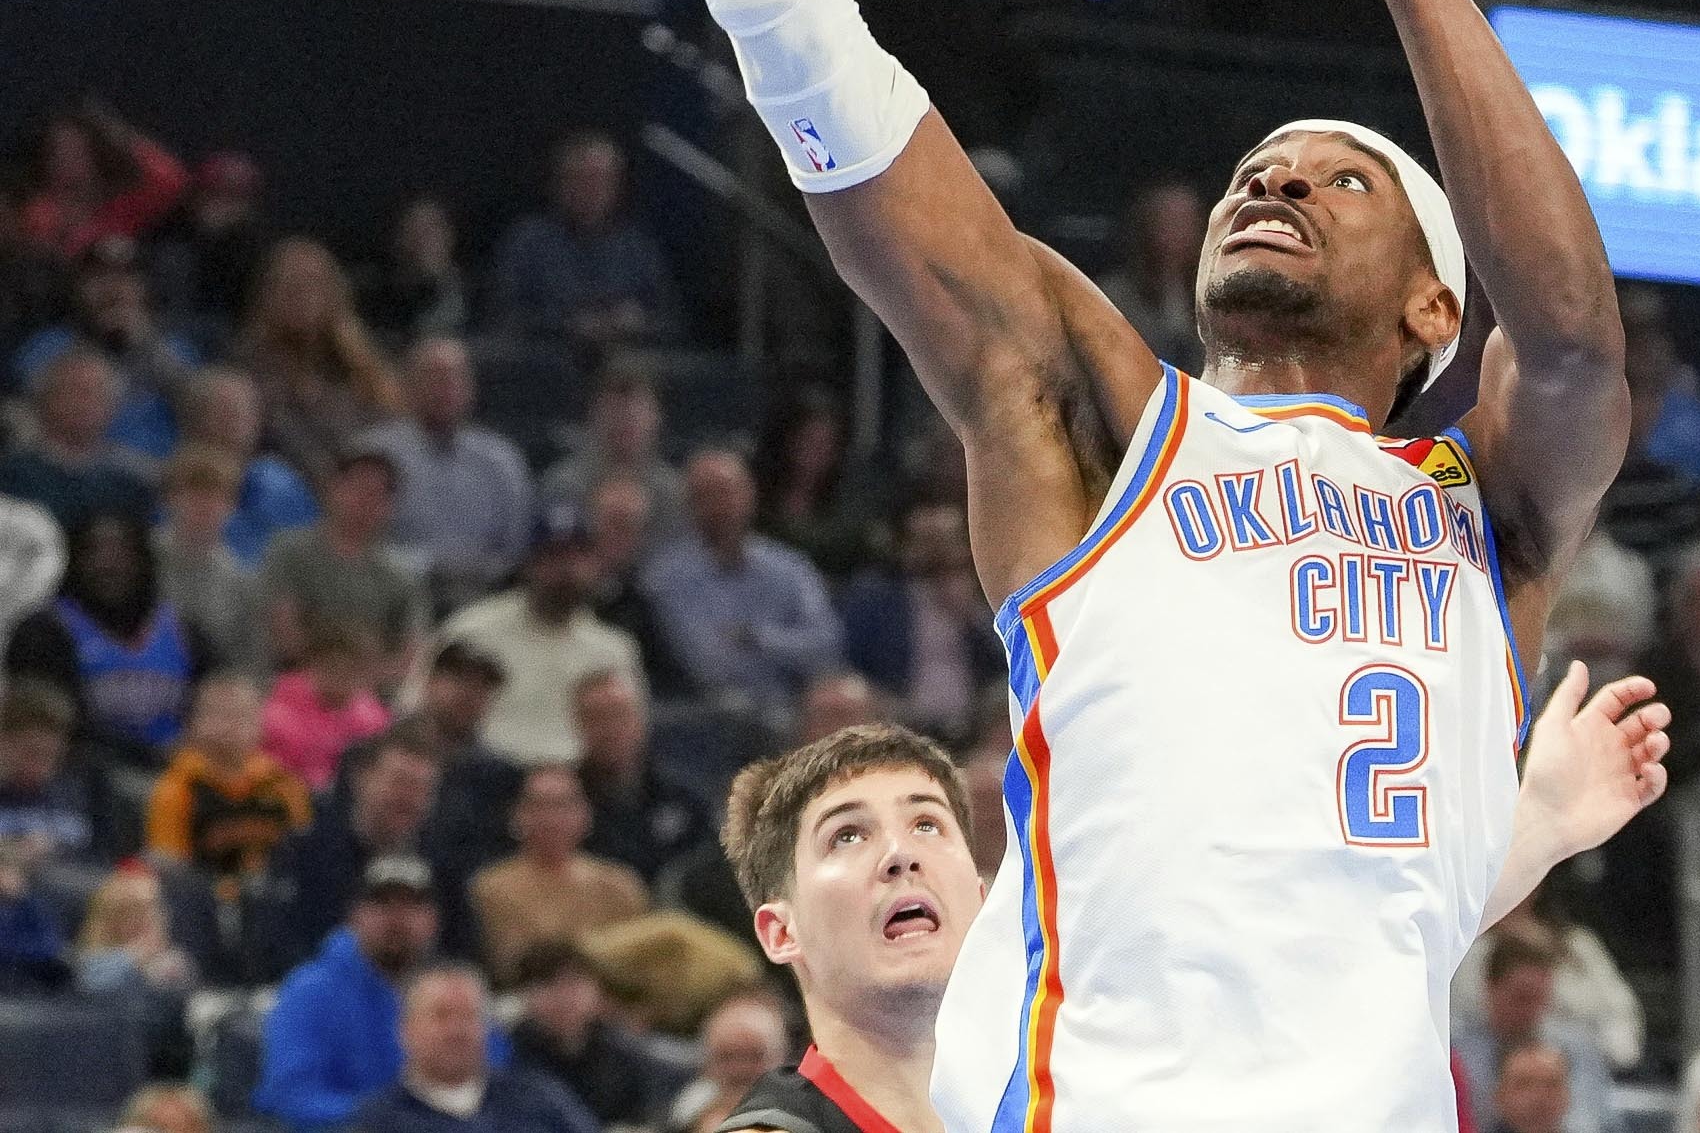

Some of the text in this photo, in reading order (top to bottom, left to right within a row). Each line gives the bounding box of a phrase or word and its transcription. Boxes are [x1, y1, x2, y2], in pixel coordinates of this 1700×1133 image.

[1163, 458, 1488, 575] OKLAHOM
[1289, 552, 1459, 653] CITY
[1336, 663, 1430, 848] 2
